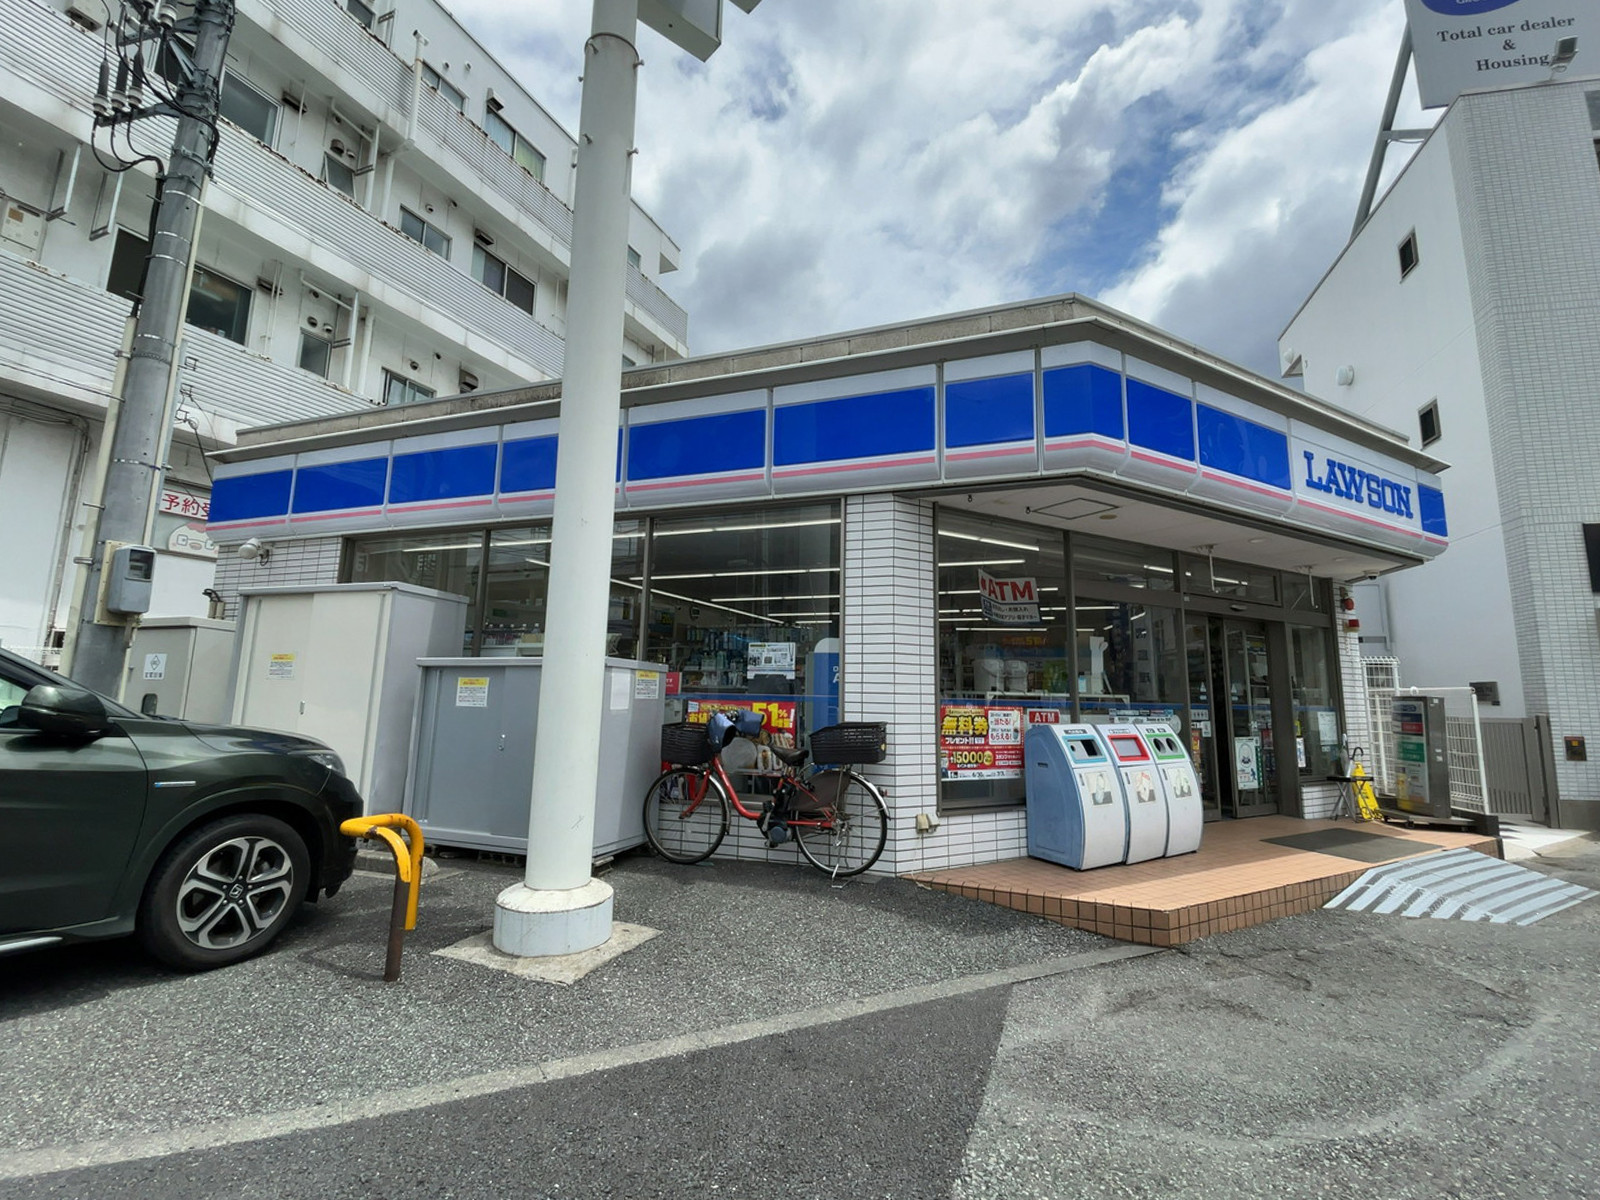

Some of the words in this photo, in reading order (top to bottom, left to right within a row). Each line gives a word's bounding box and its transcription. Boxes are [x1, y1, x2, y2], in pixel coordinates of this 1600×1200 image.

[1437, 26, 1482, 42] Total
[1487, 23, 1515, 36] car
[1520, 16, 1575, 32] dealer
[1502, 39, 1516, 51] &
[1476, 54, 1550, 71] Housing
[1303, 450, 1413, 519] LAWSON
[988, 579, 1034, 601] ATM
[942, 716, 989, 736] 無料券
[1034, 712, 1056, 724] ATM
